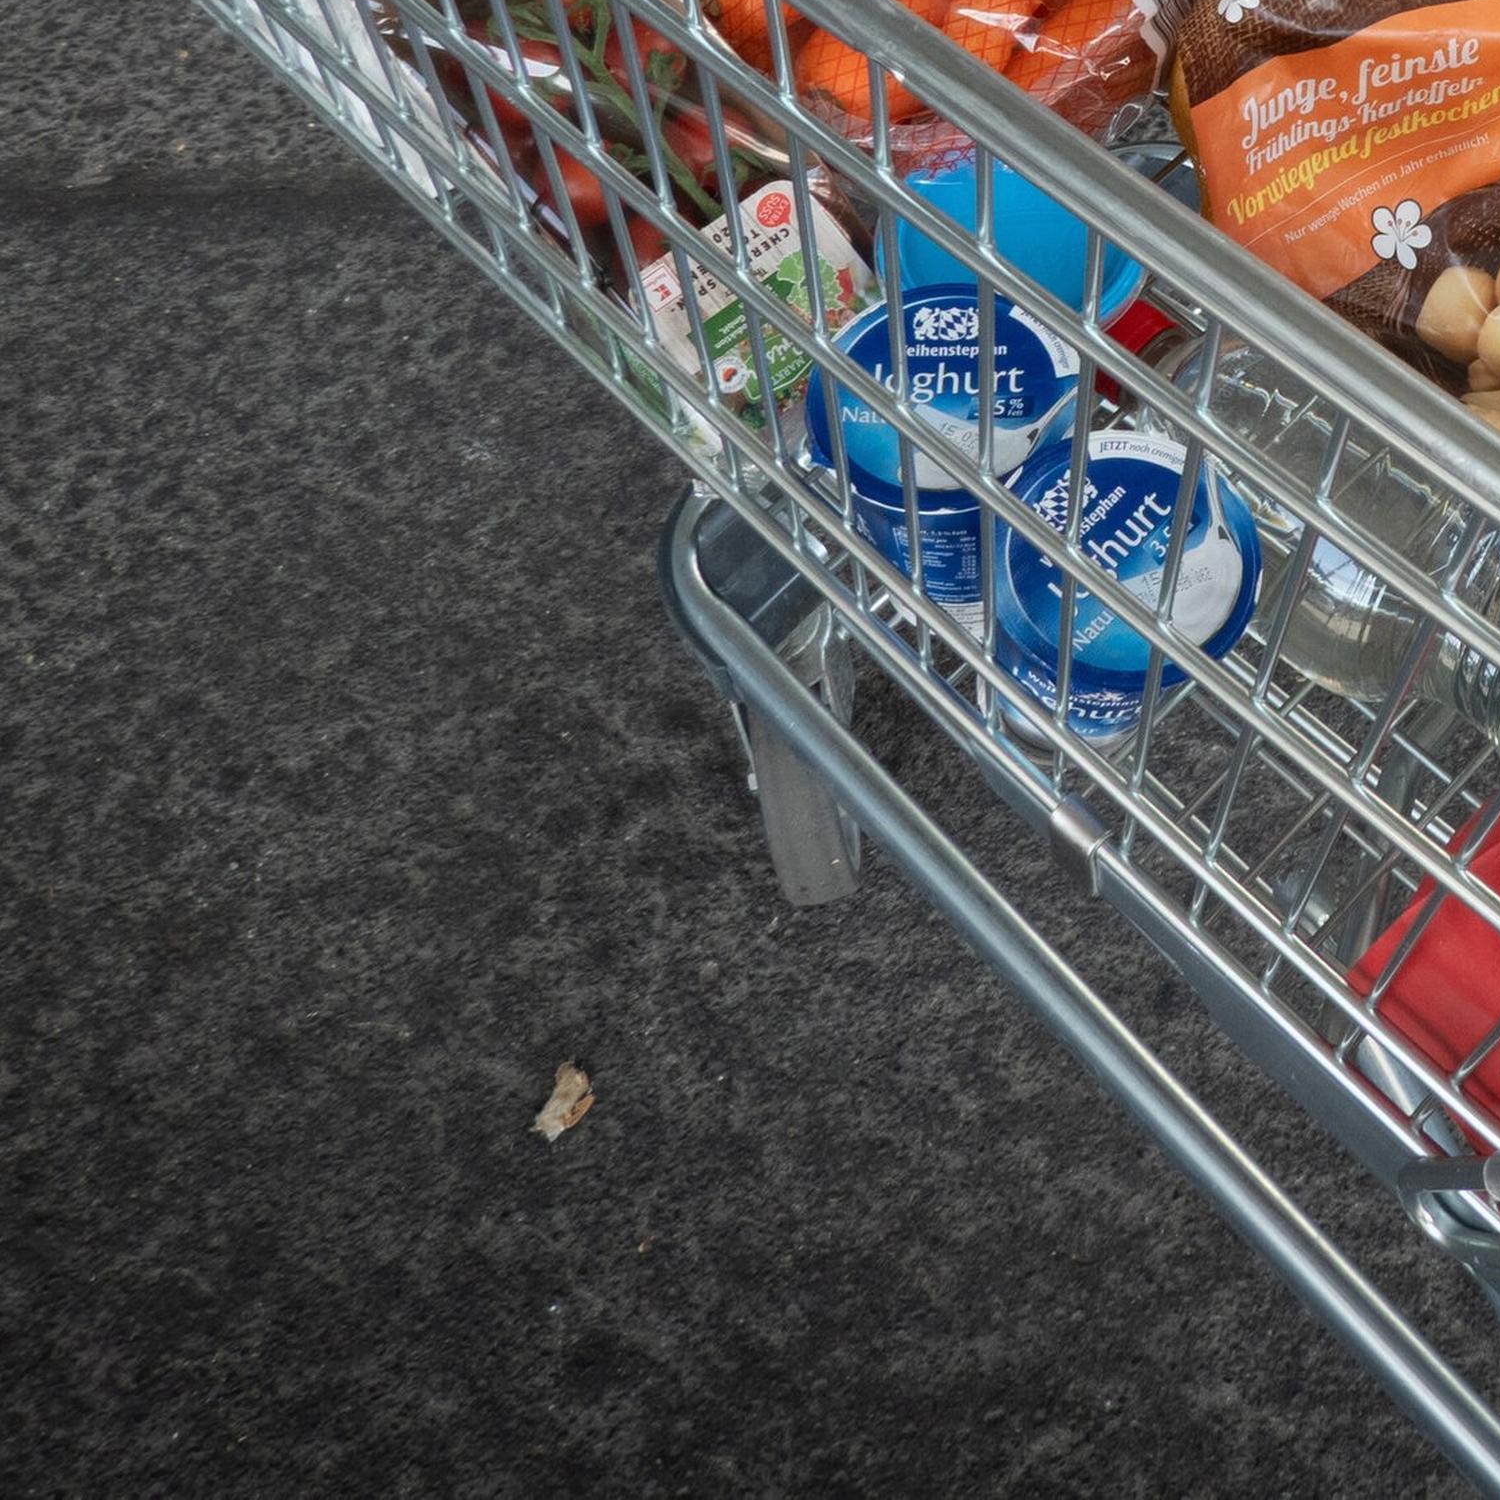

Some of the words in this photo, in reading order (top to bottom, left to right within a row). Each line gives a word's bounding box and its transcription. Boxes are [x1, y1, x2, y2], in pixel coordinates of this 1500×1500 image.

[1241, 74, 1349, 151] Junge,
[1354, 34, 1481, 105] feinste
[1244, 77, 1485, 176] Frühlings-Kartoffeln
[1226, 134, 1360, 227] Vorwiegend
[1284, 225, 1308, 246] Nur
[1336, 179, 1381, 211] Wochen
[1397, 157, 1424, 184] Jahr
[1424, 133, 1490, 166] erhältlich!
[902, 343, 1008, 357] eihenstepn
[1097, 432, 1129, 461] JETZT
[1127, 437, 1152, 457] noch
